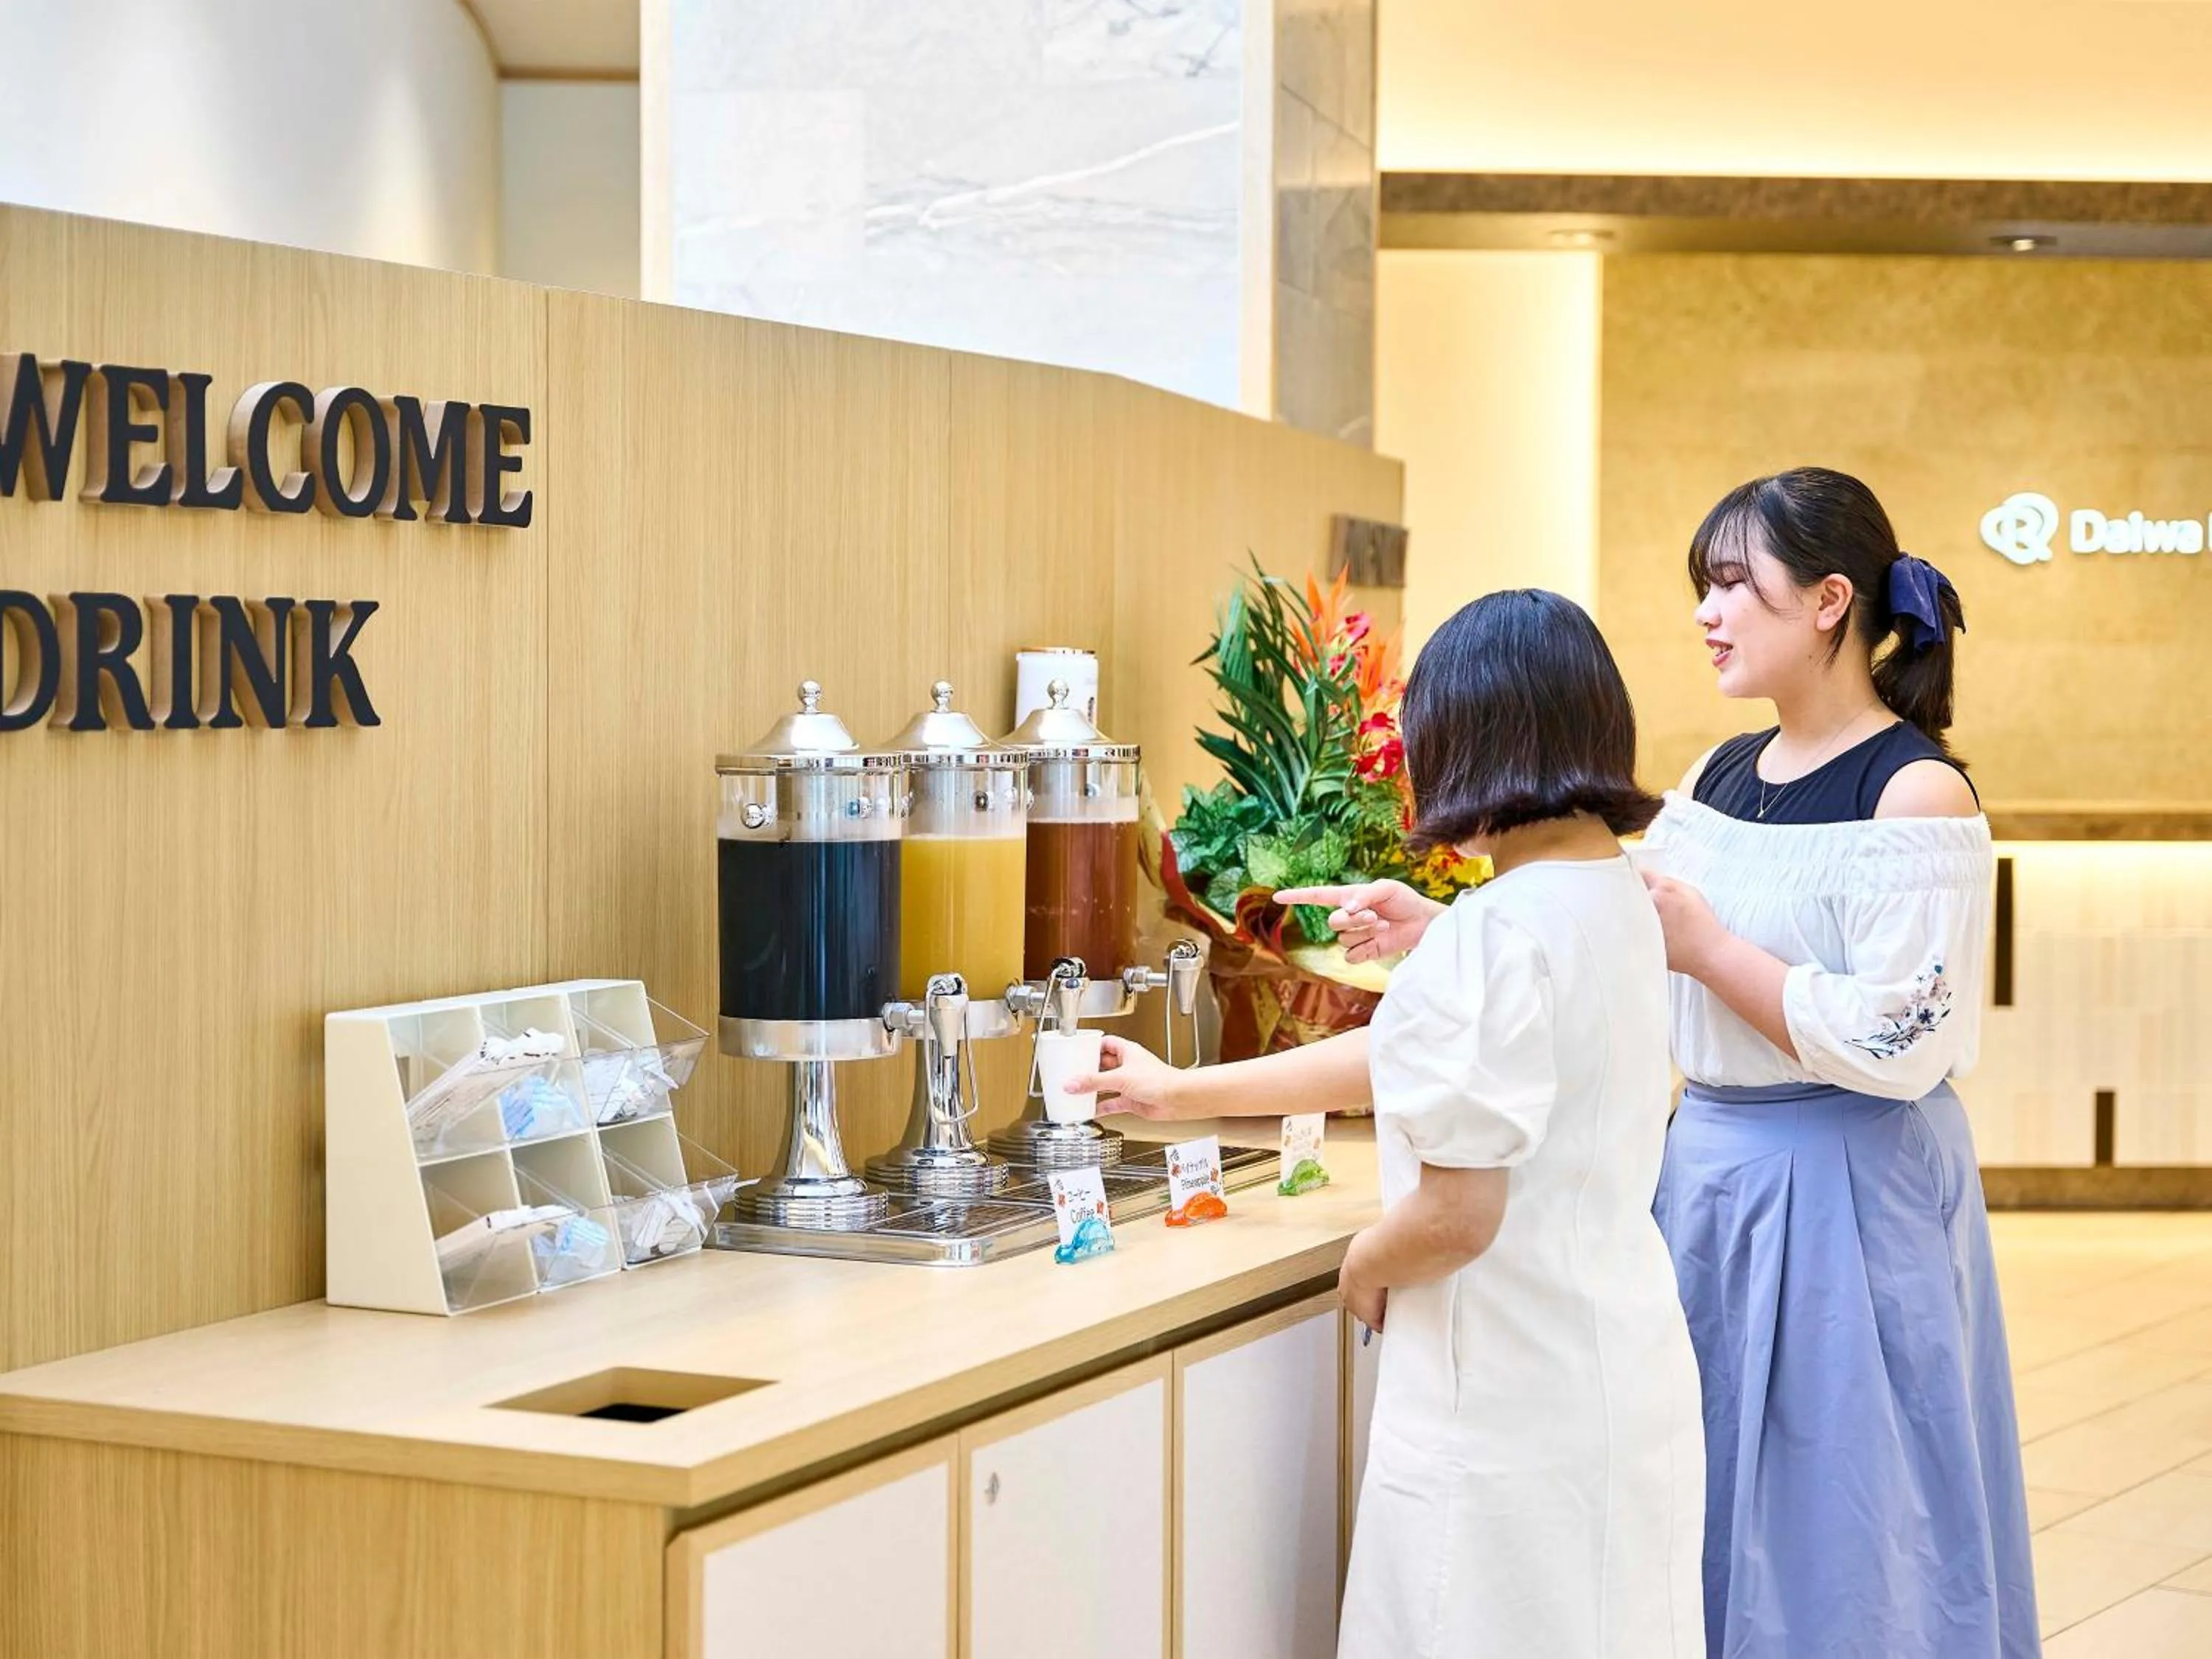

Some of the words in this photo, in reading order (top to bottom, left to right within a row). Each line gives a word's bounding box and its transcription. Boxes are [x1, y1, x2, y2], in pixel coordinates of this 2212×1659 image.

[0, 352, 533, 529] WELCOME
[2070, 508, 2204, 554] Daiwa
[0, 591, 381, 731] DRINK
